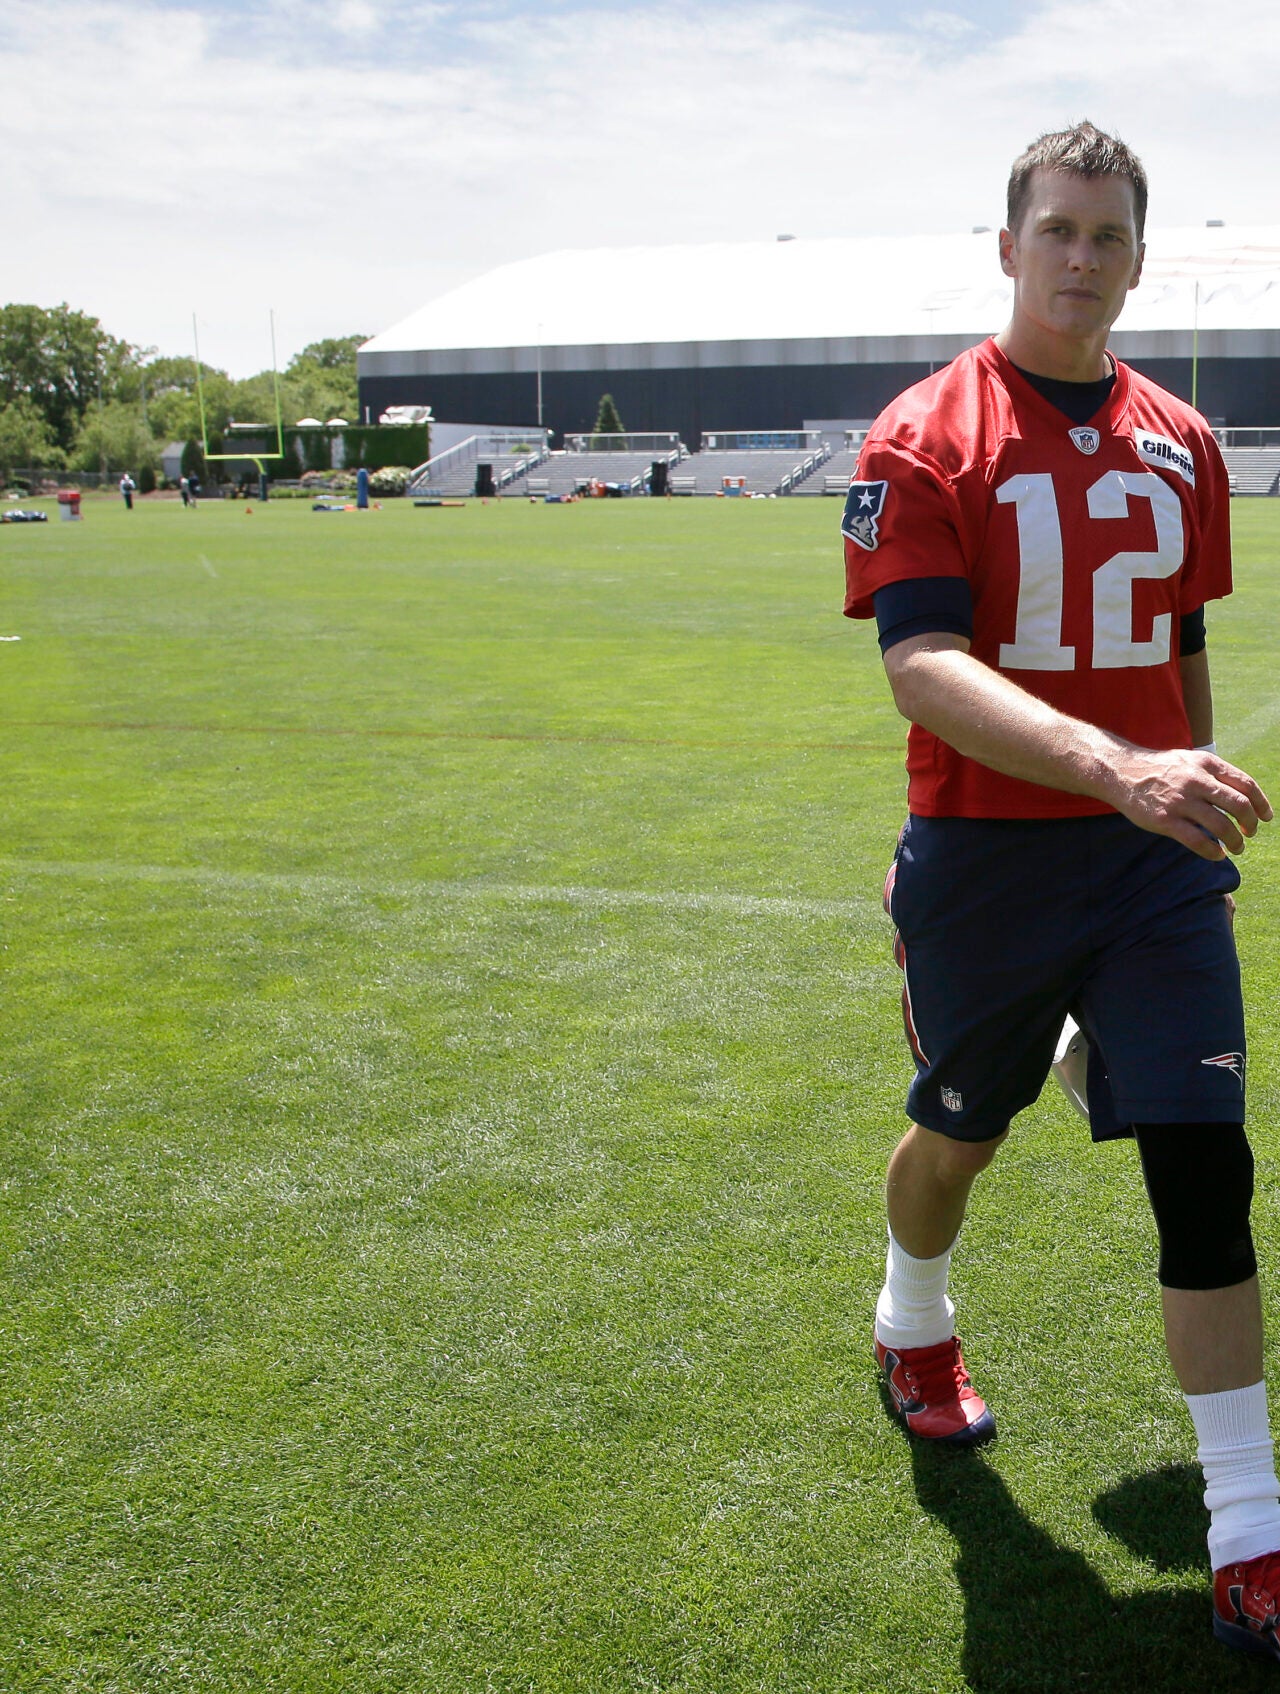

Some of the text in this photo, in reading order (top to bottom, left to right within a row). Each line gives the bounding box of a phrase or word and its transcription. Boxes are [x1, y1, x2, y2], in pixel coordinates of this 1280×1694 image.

[1142, 440, 1193, 476] Gillette
[995, 470, 1184, 671] 12
[944, 1097, 960, 1109] NFL
